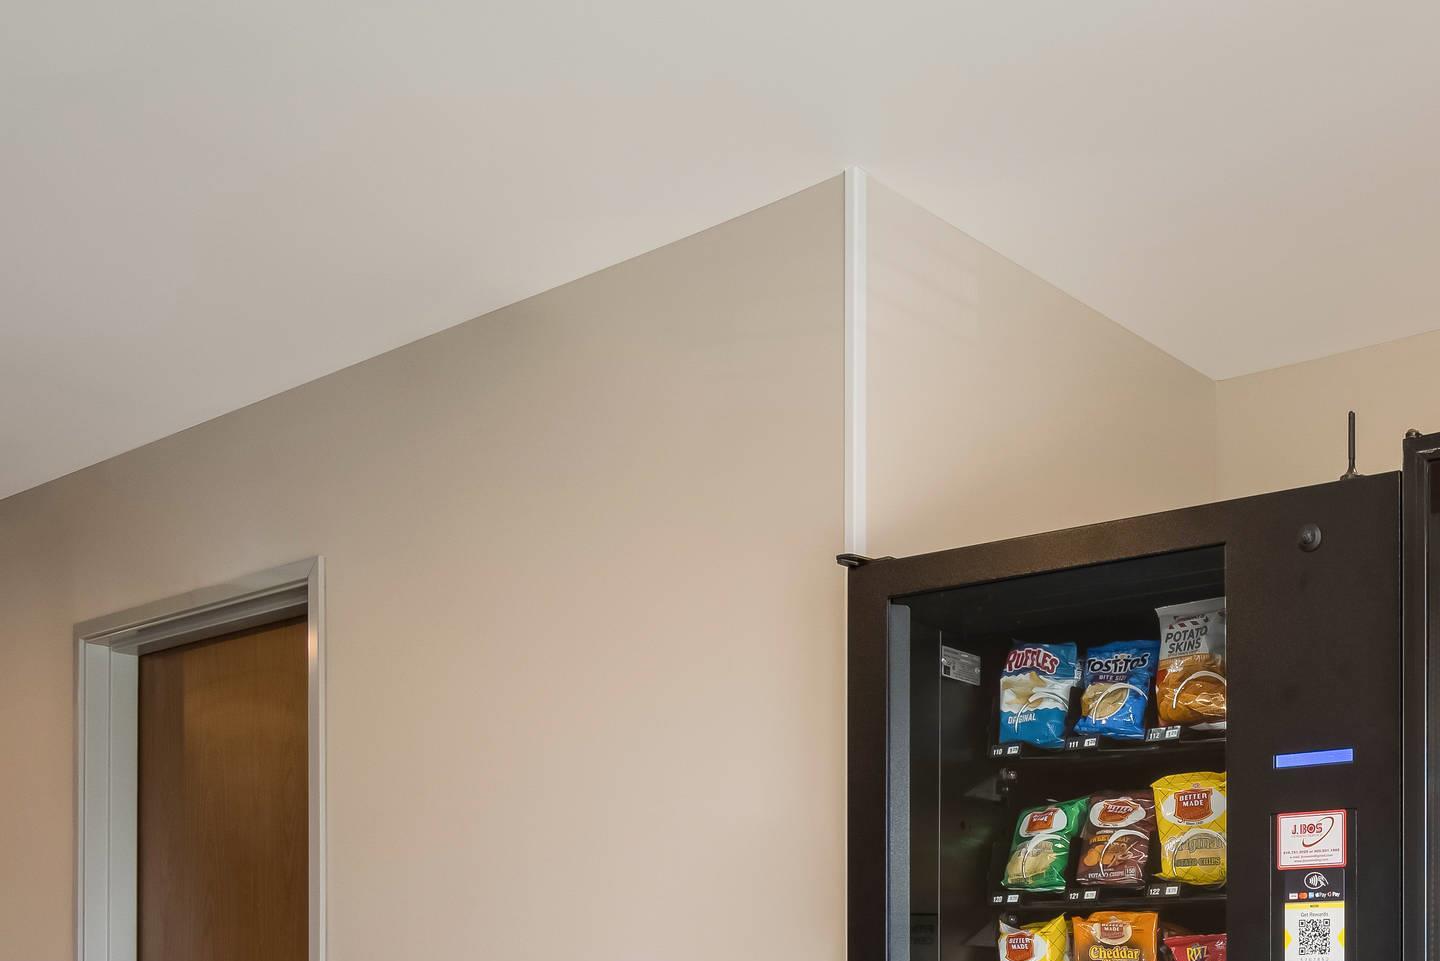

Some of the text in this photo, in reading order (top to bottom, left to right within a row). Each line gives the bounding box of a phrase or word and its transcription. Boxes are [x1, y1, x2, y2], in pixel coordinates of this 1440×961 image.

[1165, 625, 1209, 643] POTATO
[1168, 638, 1202, 654] SKINS
[1006, 648, 1060, 675] RUFFLES
[1087, 652, 1150, 674] TOSTITOS
[1179, 792, 1208, 802] BETTER
[1089, 945, 1141, 961] Cheddar
[1186, 945, 1209, 961] RITZ
